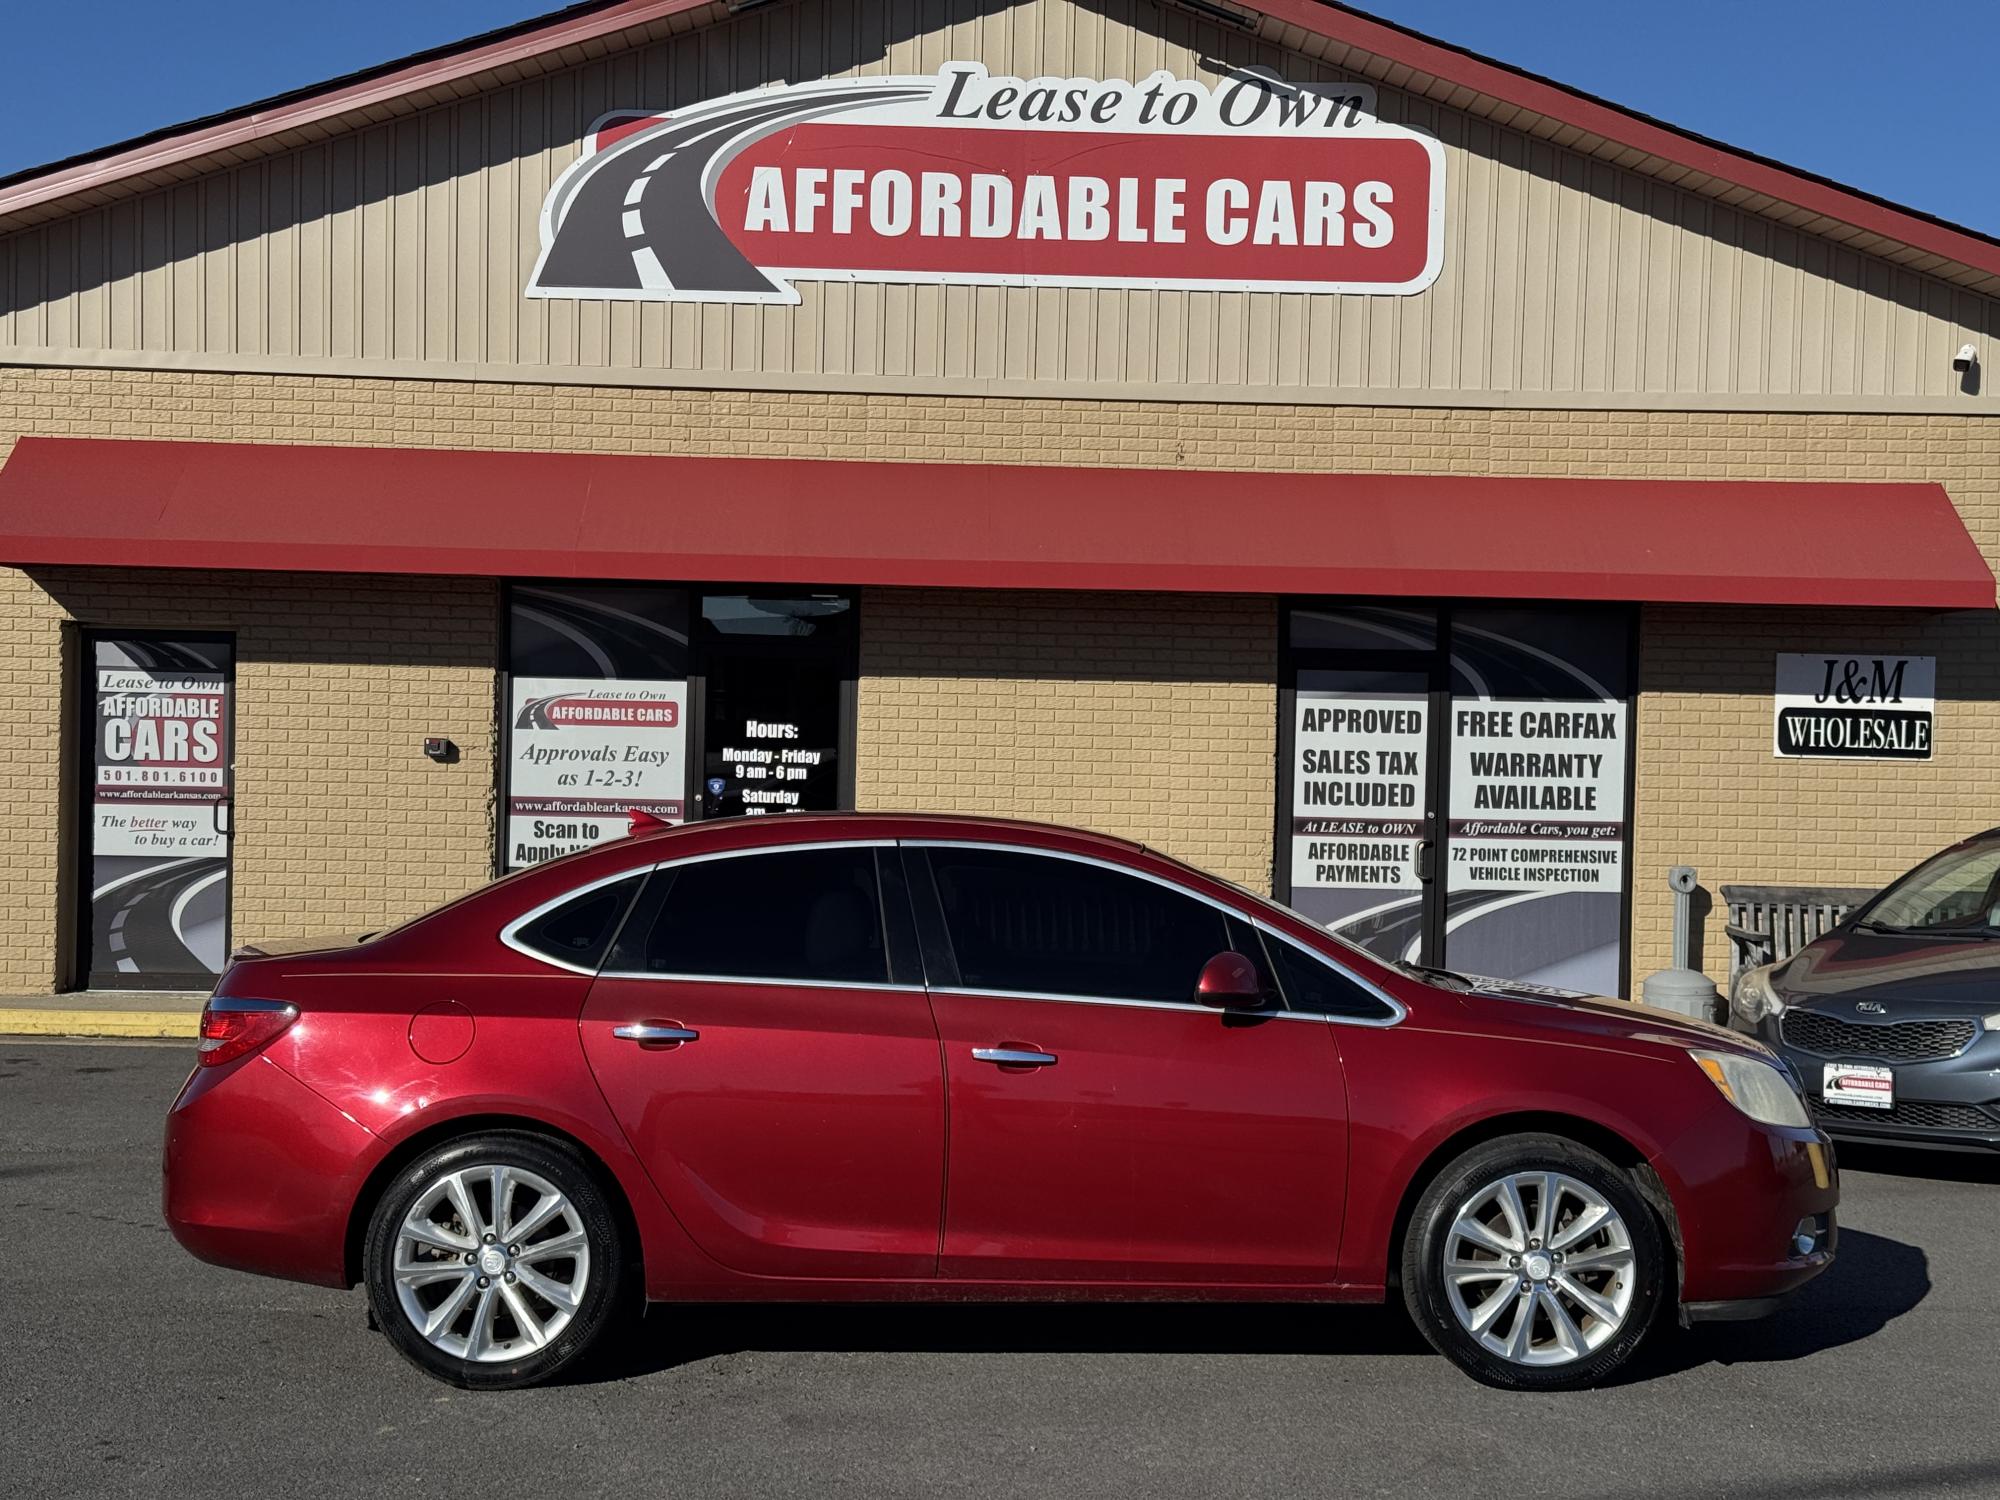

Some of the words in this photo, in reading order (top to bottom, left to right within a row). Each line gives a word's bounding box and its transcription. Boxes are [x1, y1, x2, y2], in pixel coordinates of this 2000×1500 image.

[937, 71, 1122, 123] Lease
[1138, 82, 1198, 125] to
[1219, 79, 1364, 128] Own
[744, 166, 1186, 244] AFFORDABLE
[1205, 178, 1395, 248] CARS
[103, 674, 153, 689] Lease
[159, 678, 175, 690] to
[181, 676, 220, 690] Own
[1814, 659, 1909, 704] J&M
[587, 689, 622, 700] Lease
[626, 691, 636, 700] to
[639, 690, 666, 700] Own
[103, 696, 219, 718] AFFORDABLE
[552, 706, 634, 721] AFFORDABLE
[636, 708, 673, 722] CARS
[746, 720, 799, 739] Hours:
[1301, 708, 1422, 734] APPROVED
[1457, 710, 1513, 738] FREE
[1520, 711, 1617, 739] CARFAX
[104, 718, 218, 763] CARS
[1785, 716, 1930, 750] WHOLESALE
[520, 743, 617, 765] Approvals
[622, 745, 669, 767] Easy
[722, 747, 773, 764] Monday
[781, 749, 820, 765] Friday
[1302, 749, 1370, 775] SALES
[1376, 751, 1419, 776] TAX
[735, 764, 744, 778] 9
[746, 767, 766, 778] am
[776, 765, 785, 779] 6
[786, 768, 807, 781] pm
[1470, 752, 1603, 778] WARRANTY
[103, 769, 218, 783] 501.801.6100
[557, 773, 578, 786] as
[584, 769, 643, 787] 1-2-3!
[99, 790, 221, 800] www.affordablearkansas.com
[742, 789, 799, 805] Saturday
[1303, 781, 1415, 807] INCLUDED
[1474, 784, 1597, 811] AVAILABLE
[515, 801, 678, 814] www.affordablearkansas.com
[101, 815, 126, 828] The
[130, 816, 168, 828] better
[172, 820, 197, 831] way
[533, 820, 578, 839] Scan
[582, 822, 599, 840] to
[1302, 821, 1317, 833] At
[1320, 821, 1365, 834] LEASE
[1367, 824, 1379, 834] to
[1382, 823, 1416, 835] OWN
[1460, 822, 1527, 836] Affordable
[1530, 823, 1562, 837] Cars,
[1566, 826, 1588, 837] you
[1591, 826, 1616, 838] get:
[134, 834, 148, 845] to
[151, 833, 175, 848] buy
[178, 837, 187, 846] a
[190, 835, 219, 846] car!
[1308, 842, 1409, 862] AFFORDABLE
[1452, 848, 1467, 861] 72
[1470, 848, 1508, 862] POINT
[1511, 848, 1617, 864] COMPREHENSIVE
[1316, 864, 1401, 883] PAYMENTS
[1469, 866, 1521, 881] VEHICLE
[1524, 868, 1599, 882] INSPECTION
